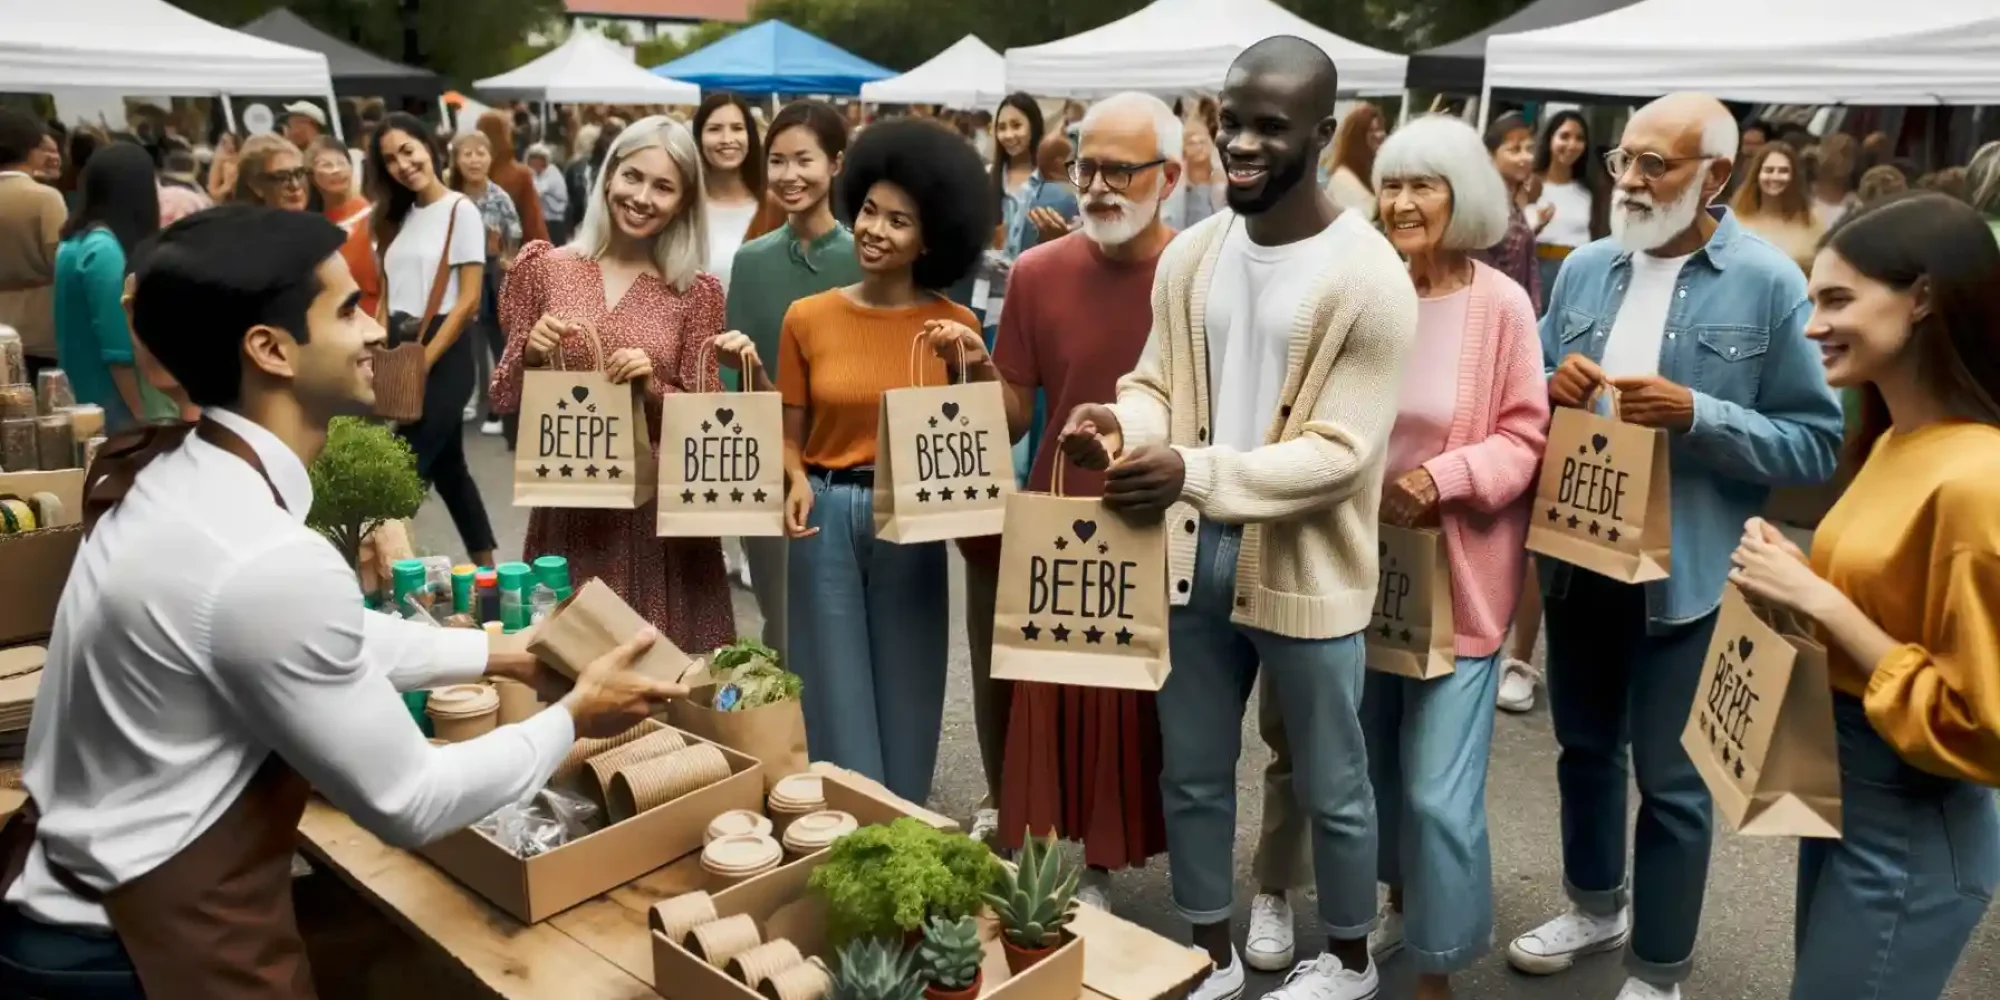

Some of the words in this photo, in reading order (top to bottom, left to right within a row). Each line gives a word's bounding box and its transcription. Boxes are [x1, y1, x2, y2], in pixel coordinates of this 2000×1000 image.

[539, 413, 620, 460] BEEPE
[684, 436, 761, 483] BEEEB
[915, 430, 991, 482] BESBE
[1029, 555, 1138, 620] BEEBE
